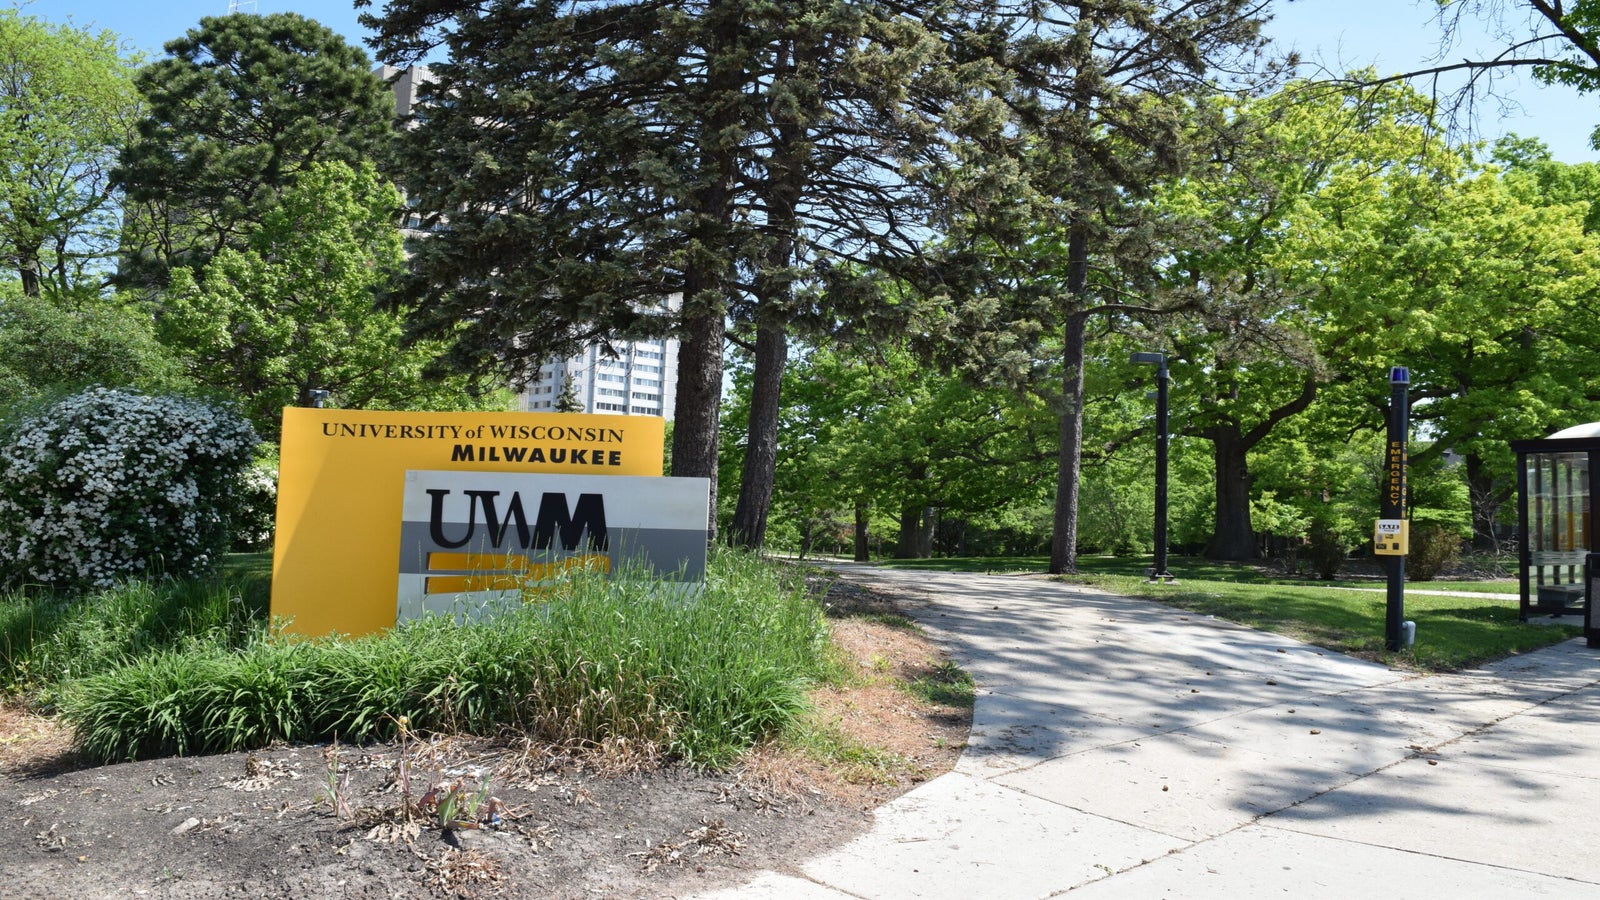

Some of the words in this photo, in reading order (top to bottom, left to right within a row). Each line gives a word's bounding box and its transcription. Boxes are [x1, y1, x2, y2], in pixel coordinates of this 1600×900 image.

[321, 422, 462, 439] UNIVERSITY
[465, 425, 485, 439] of
[490, 425, 624, 443] WISCONSIN
[451, 444, 621, 466] MILWAUKEE
[1390, 441, 1401, 506] EMERGENCY
[426, 489, 609, 551] UWM
